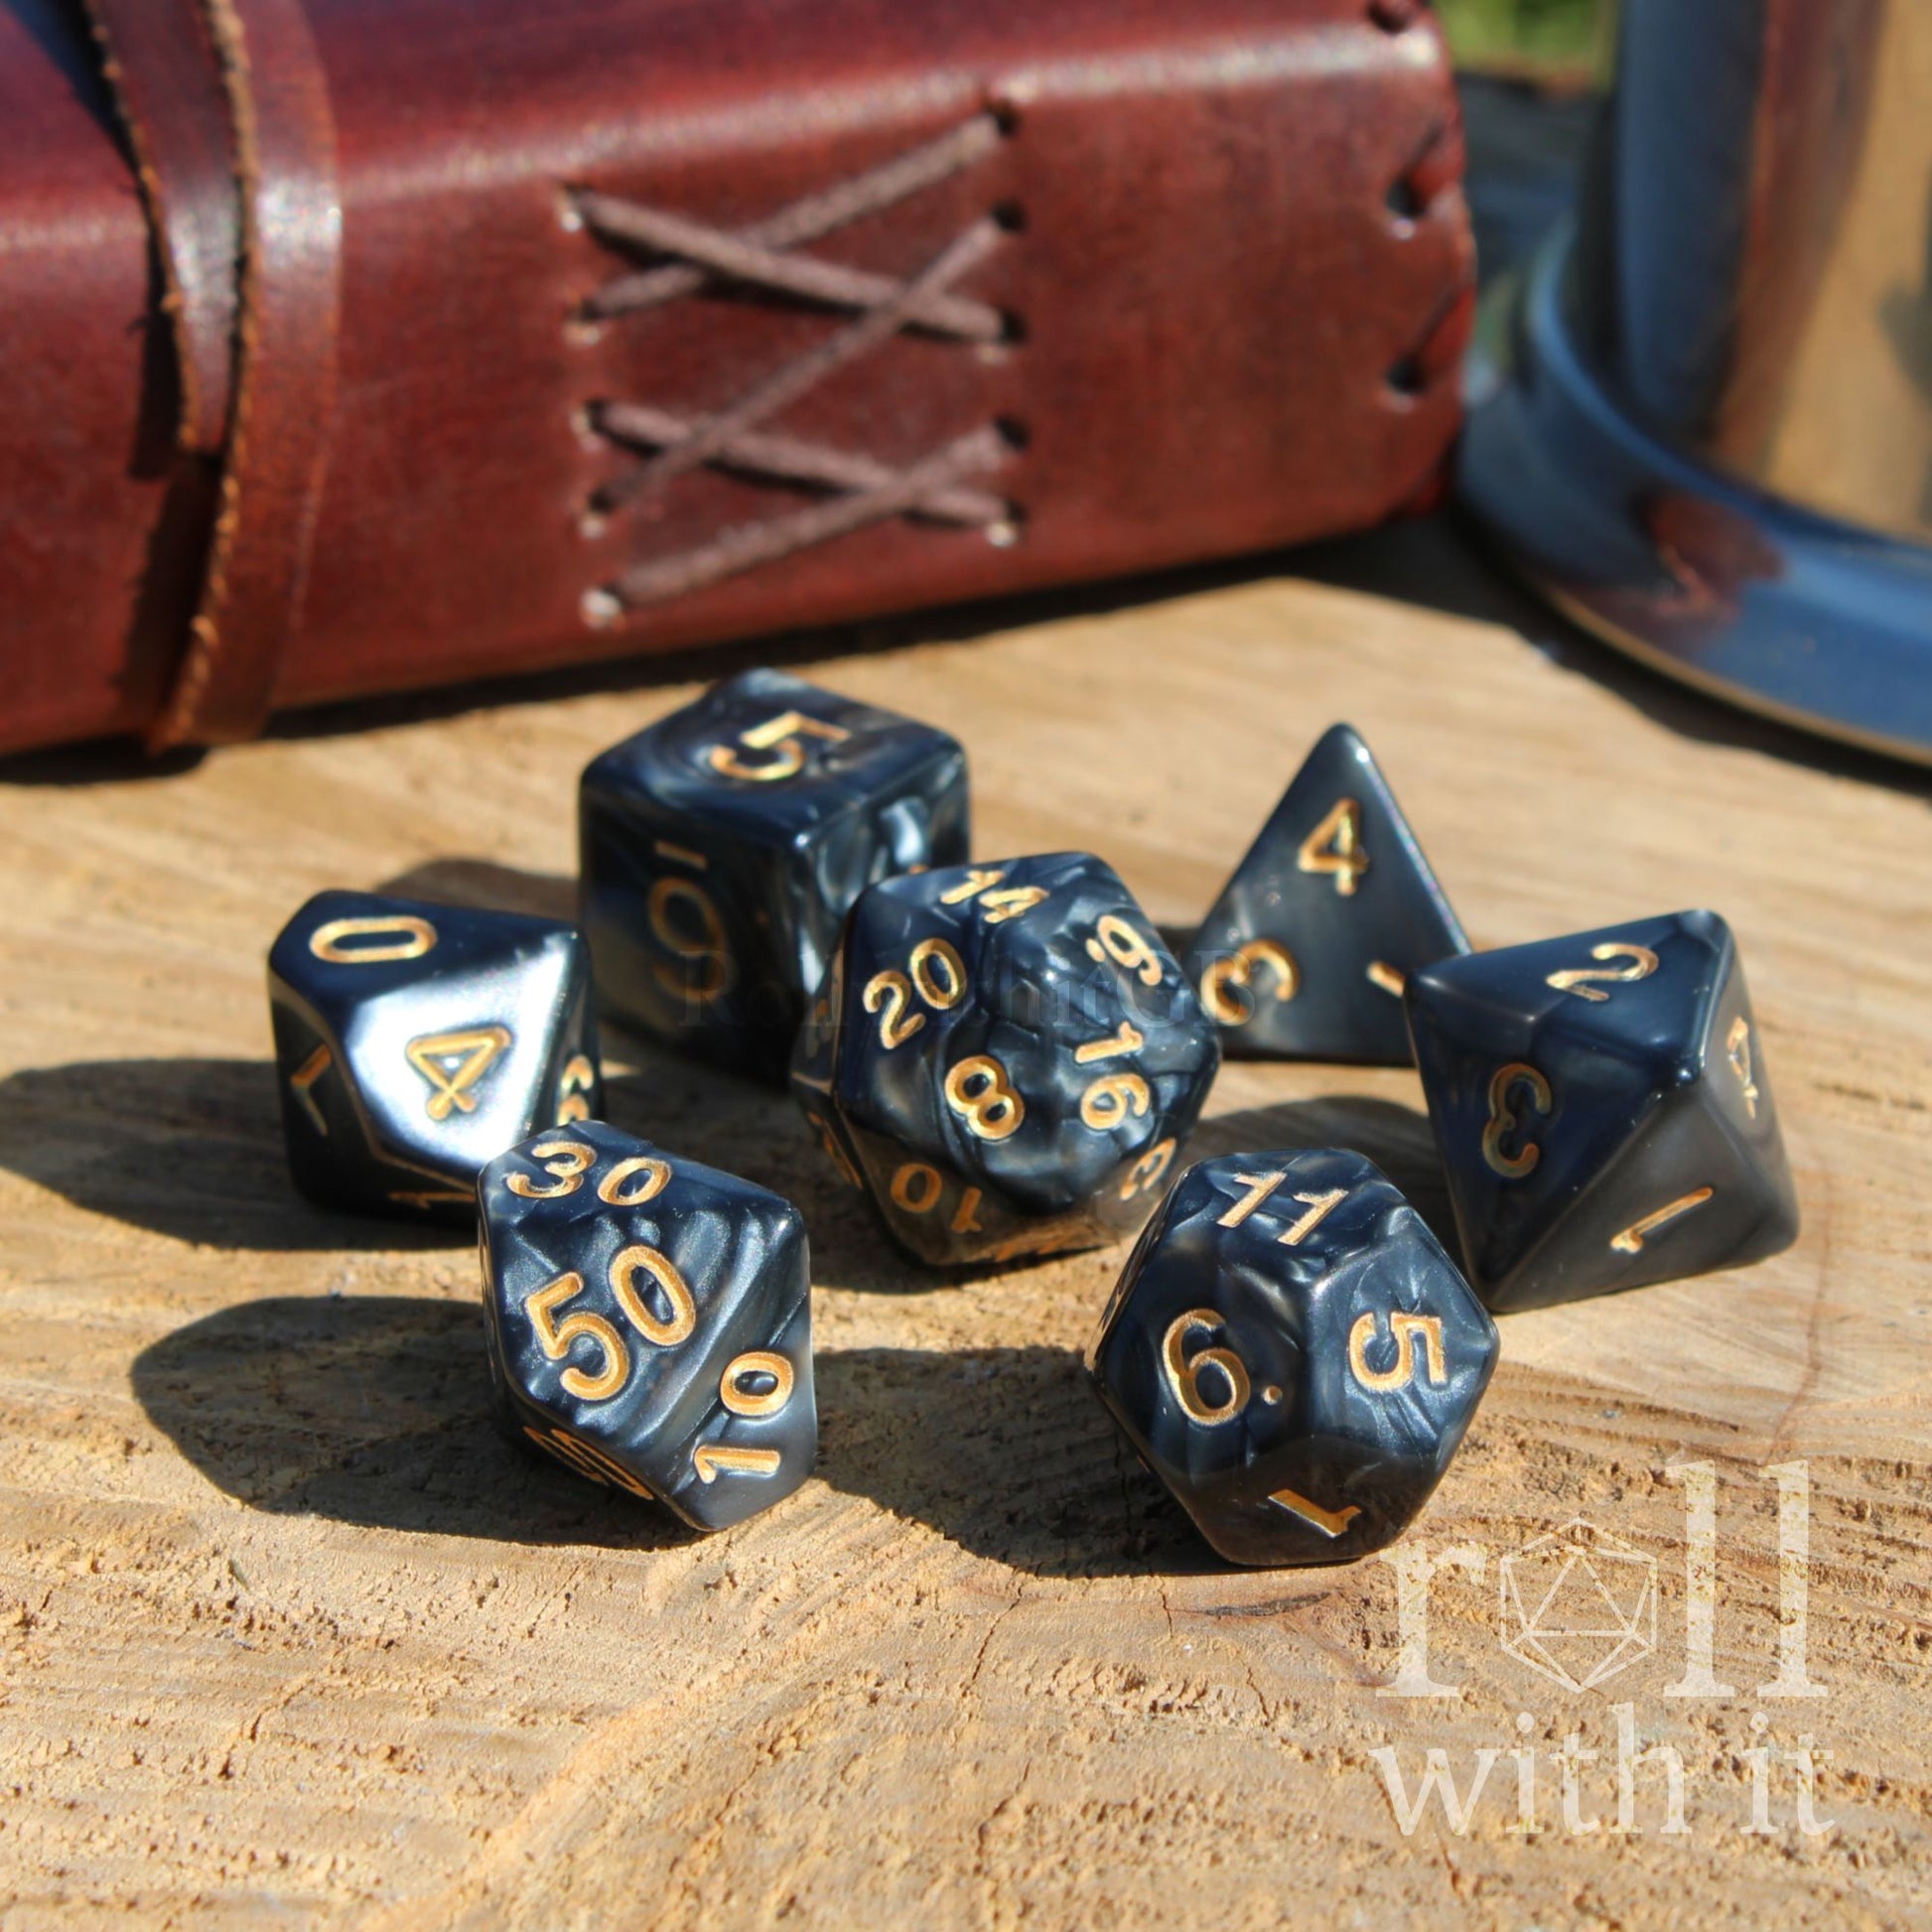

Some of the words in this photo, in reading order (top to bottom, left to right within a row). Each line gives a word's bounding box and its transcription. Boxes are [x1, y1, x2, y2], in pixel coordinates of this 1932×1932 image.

[711, 711, 851, 781] 5
[1298, 798, 1369, 896] 4
[310, 916, 438, 964] 0
[1201, 937, 1301, 1026] 3
[1547, 941, 1660, 1003] 2
[863, 937, 968, 1050] 20
[406, 1027, 511, 1121] 4
[945, 1055, 1025, 1141] 8
[1075, 1022, 1151, 1131] 16
[1482, 1062, 1554, 1178] 3
[507, 1142, 672, 1206] 30
[891, 1163, 983, 1234] 10
[1217, 1172, 1349, 1246] 11
[1609, 1185, 1715, 1254] 1
[526, 1245, 696, 1402] 50
[1347, 1311, 1449, 1394] 5
[694, 1351, 795, 1484] 10
[1267, 1489, 1362, 1539] 1
